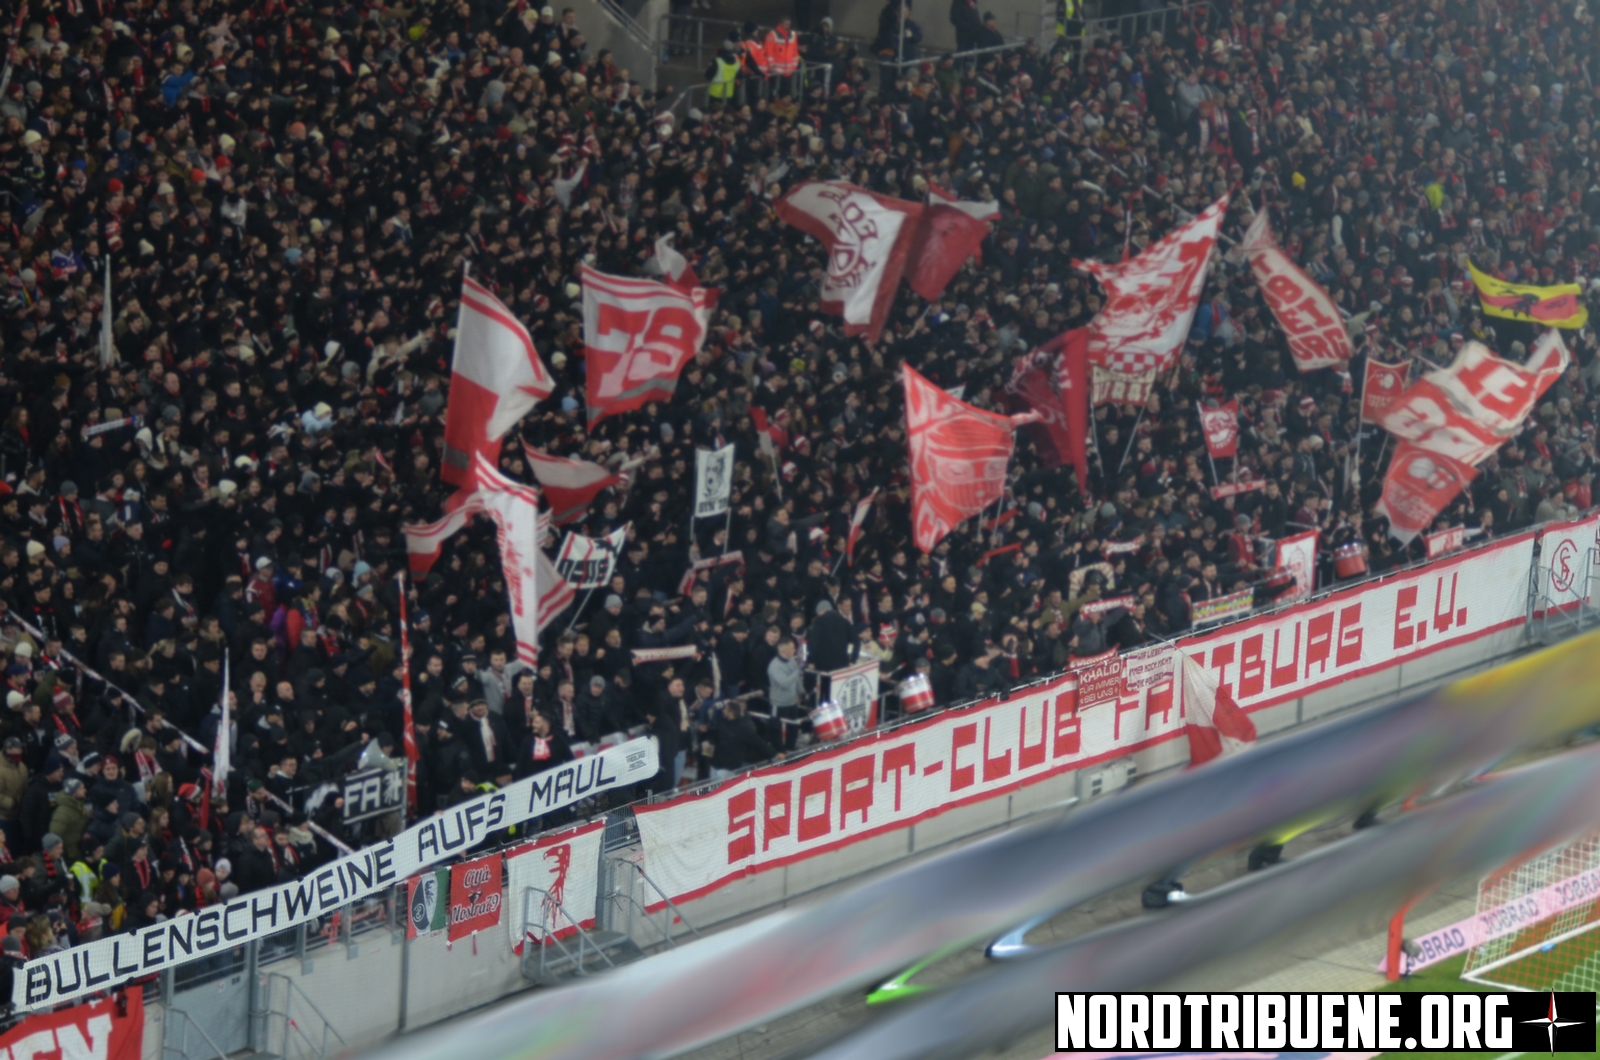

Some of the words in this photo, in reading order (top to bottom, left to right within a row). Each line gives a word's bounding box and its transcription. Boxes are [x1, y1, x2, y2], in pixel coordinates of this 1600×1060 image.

[1079, 682, 1094, 695] FÜR
[1095, 677, 1120, 691] IMMER
[1080, 662, 1120, 685] KHALID
[1097, 688, 1114, 700] UNS
[728, 692, 1081, 865] SPORT-CLUB
[26, 844, 397, 1005] BULLENSCHWEINE
[418, 794, 506, 862] AUFS
[529, 757, 616, 813] MAUL
[1480, 898, 1539, 935] JOBRAD
[1555, 872, 1600, 905] JOBRA
